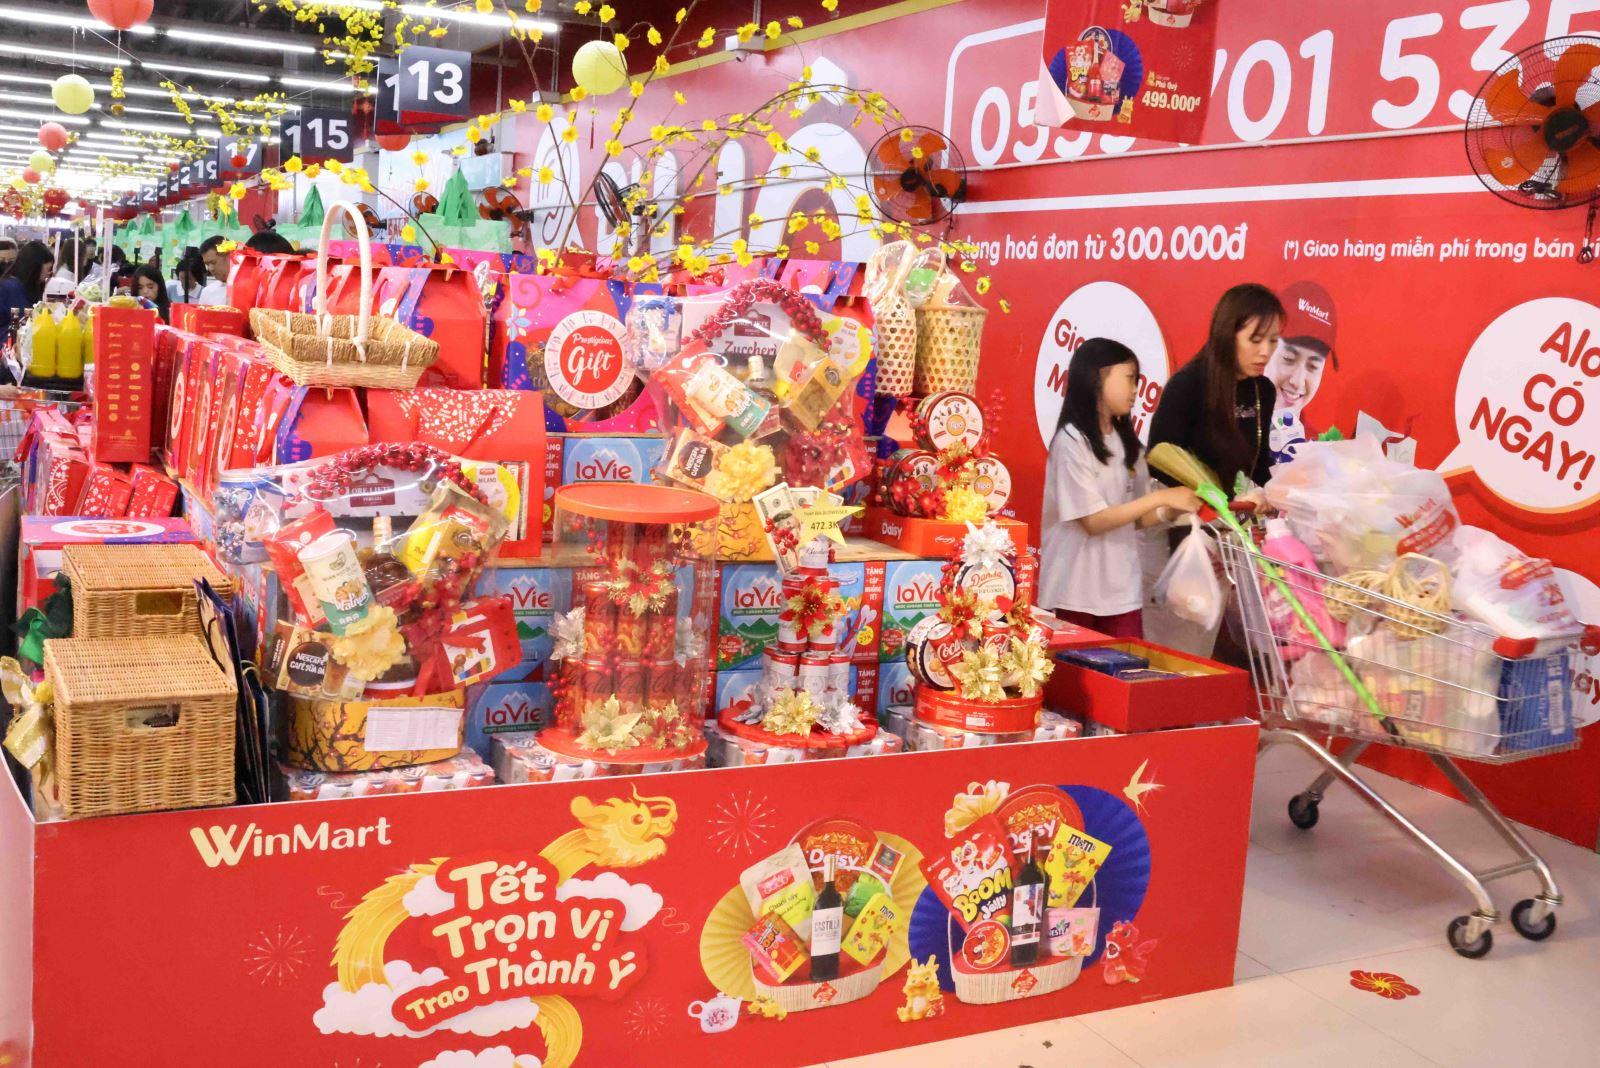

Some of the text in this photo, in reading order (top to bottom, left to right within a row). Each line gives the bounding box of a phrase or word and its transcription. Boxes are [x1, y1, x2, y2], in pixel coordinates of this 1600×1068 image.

[407, 59, 464, 105] 13
[307, 117, 349, 150] 15
[1110, 222, 1248, 261] 300.000đ
[1303, 240, 1339, 257] Giao
[1344, 237, 1386, 262] hàng
[1391, 236, 1434, 257] miễn
[1440, 238, 1470, 262] phí
[1475, 239, 1527, 263] trong
[1533, 237, 1574, 258] bán
[1298, 298, 1329, 320] WinMart
[567, 345, 616, 386] Gift
[1523, 373, 1584, 426] CÓ
[1469, 397, 1596, 491] NGAY!
[575, 459, 632, 480] laVie
[882, 521, 903, 540] Daisy
[485, 702, 544, 726] laVie
[190, 817, 392, 868] WinMart
[449, 860, 547, 911] Tết
[432, 907, 614, 958] Trọn Vị
[405, 950, 637, 1020] Trao Thành Ý
